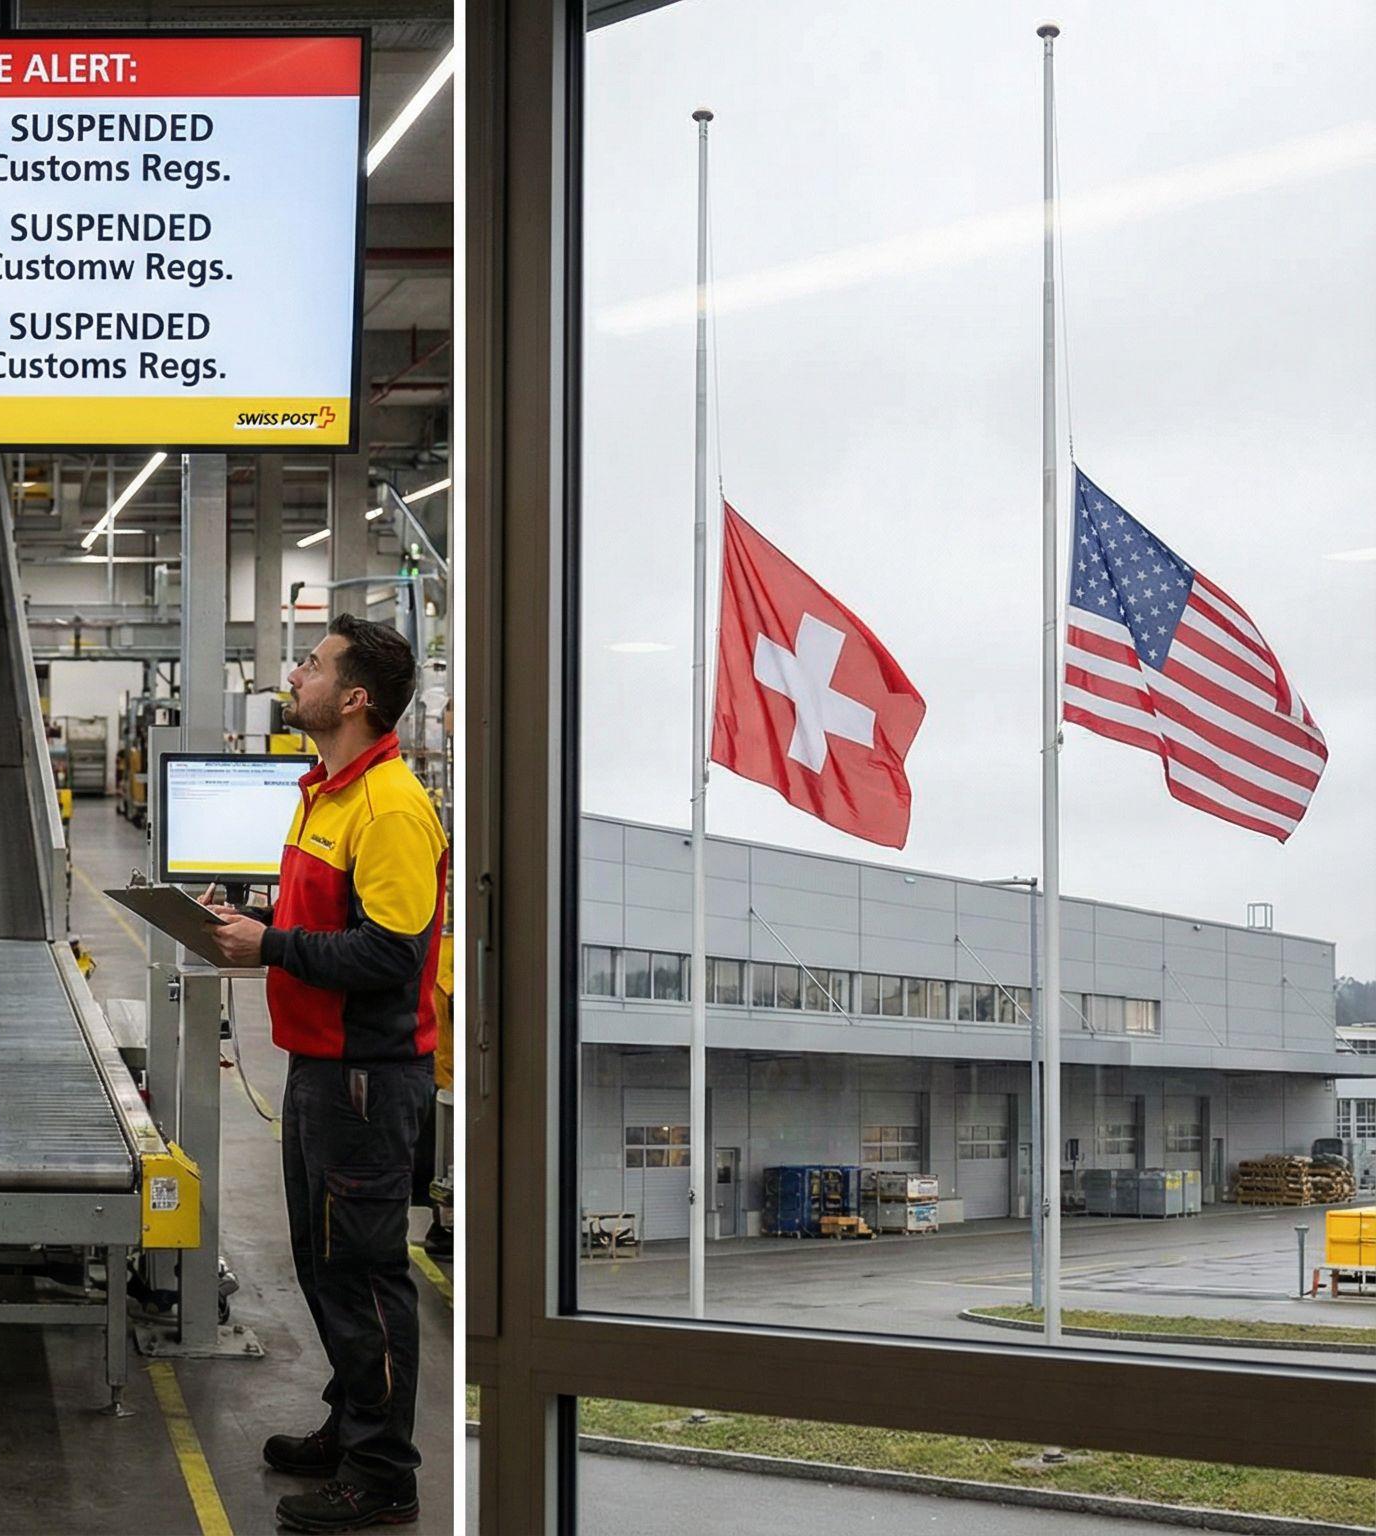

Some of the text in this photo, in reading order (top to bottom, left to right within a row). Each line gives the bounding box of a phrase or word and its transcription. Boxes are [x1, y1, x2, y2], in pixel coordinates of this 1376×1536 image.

[22, 53, 137, 83] ALERT:
[11, 113, 214, 143] SUSPENDED
[142, 153, 231, 190] Regs.
[10, 213, 212, 242] SUSPENDED
[146, 252, 233, 288] Regs.
[9, 312, 210, 340] SUSPENDED
[139, 351, 226, 387] Regs.
